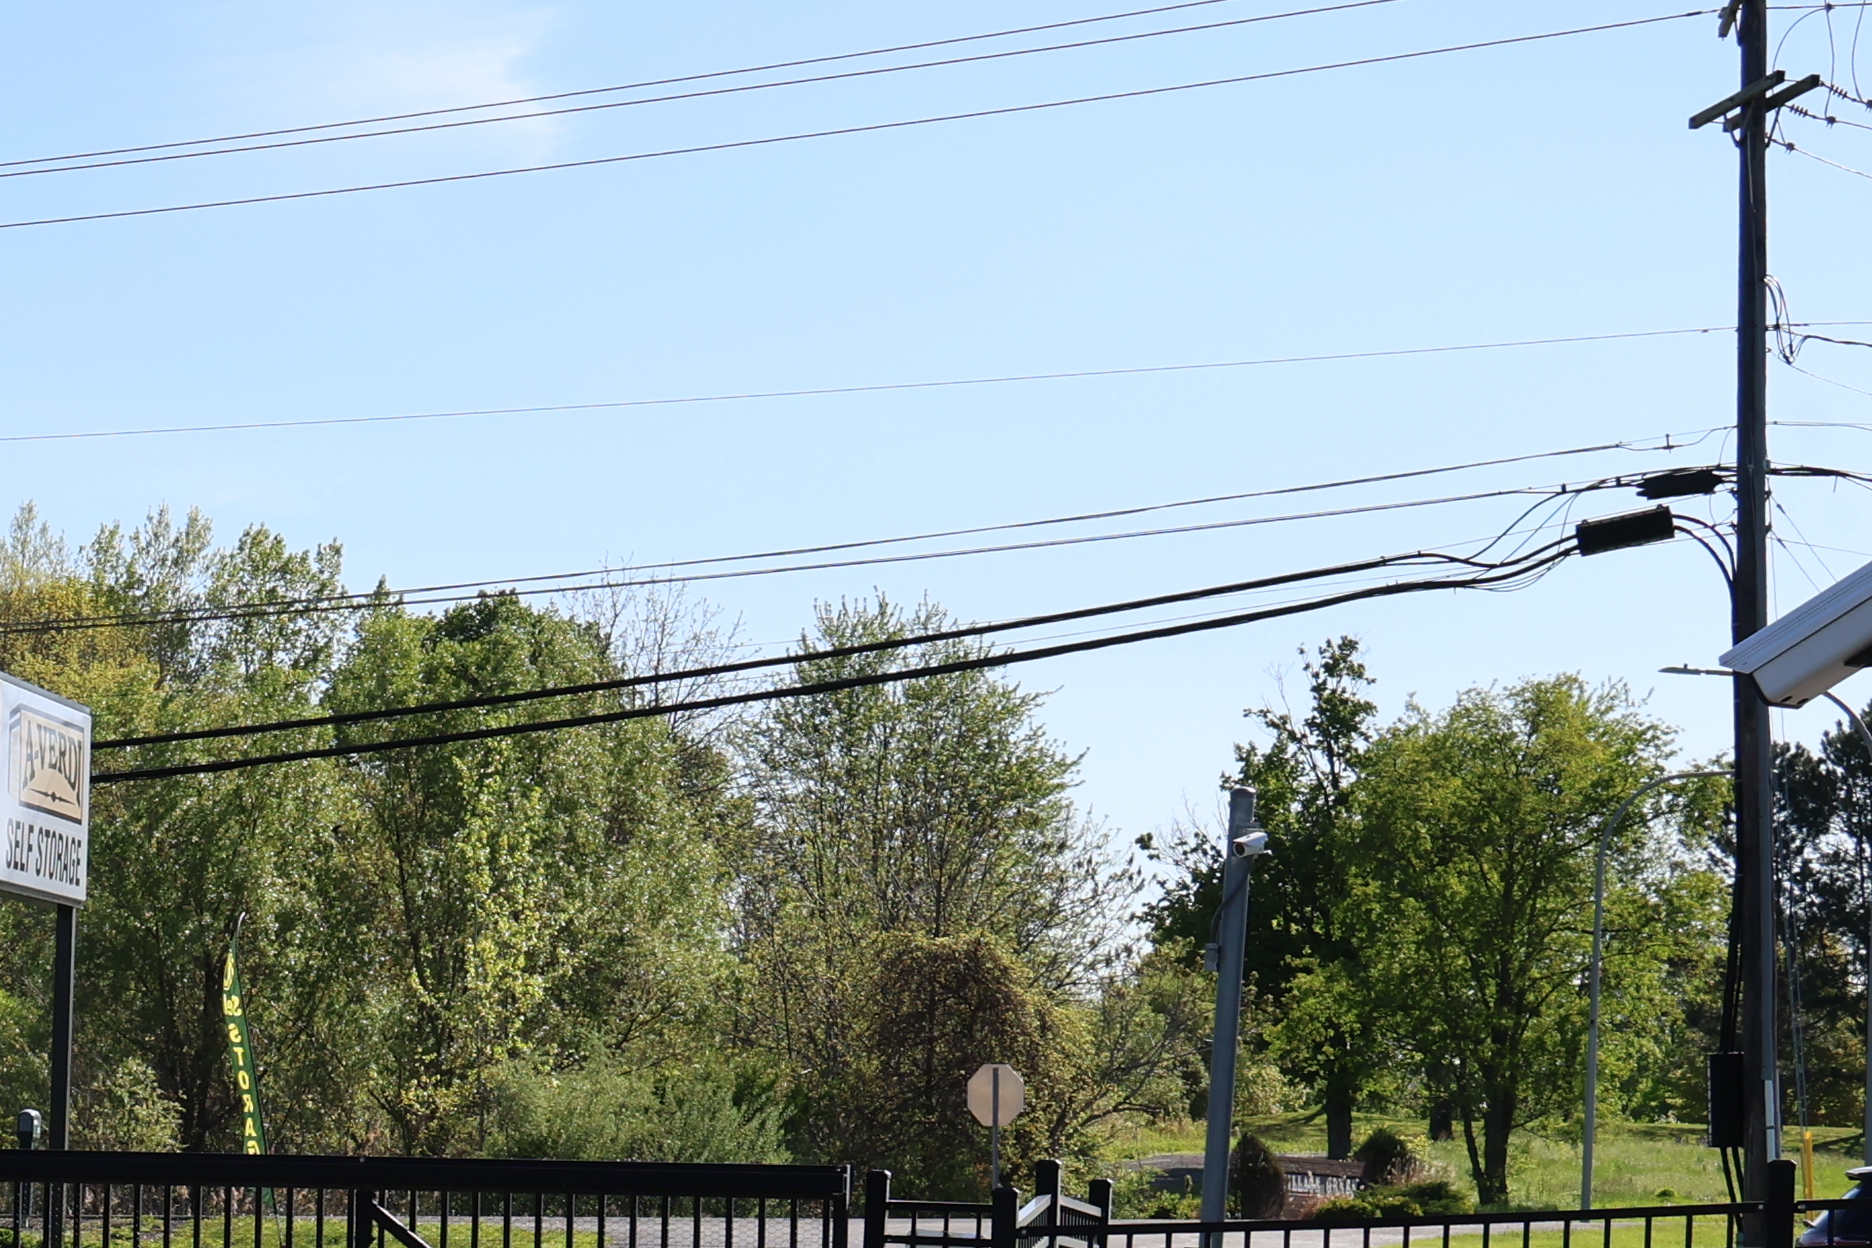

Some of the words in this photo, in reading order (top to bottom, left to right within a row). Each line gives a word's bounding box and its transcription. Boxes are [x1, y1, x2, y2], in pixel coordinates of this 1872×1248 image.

[22, 720, 83, 806] A-VERDI
[6, 817, 33, 873] SELF
[35, 827, 82, 887] STORAGE
